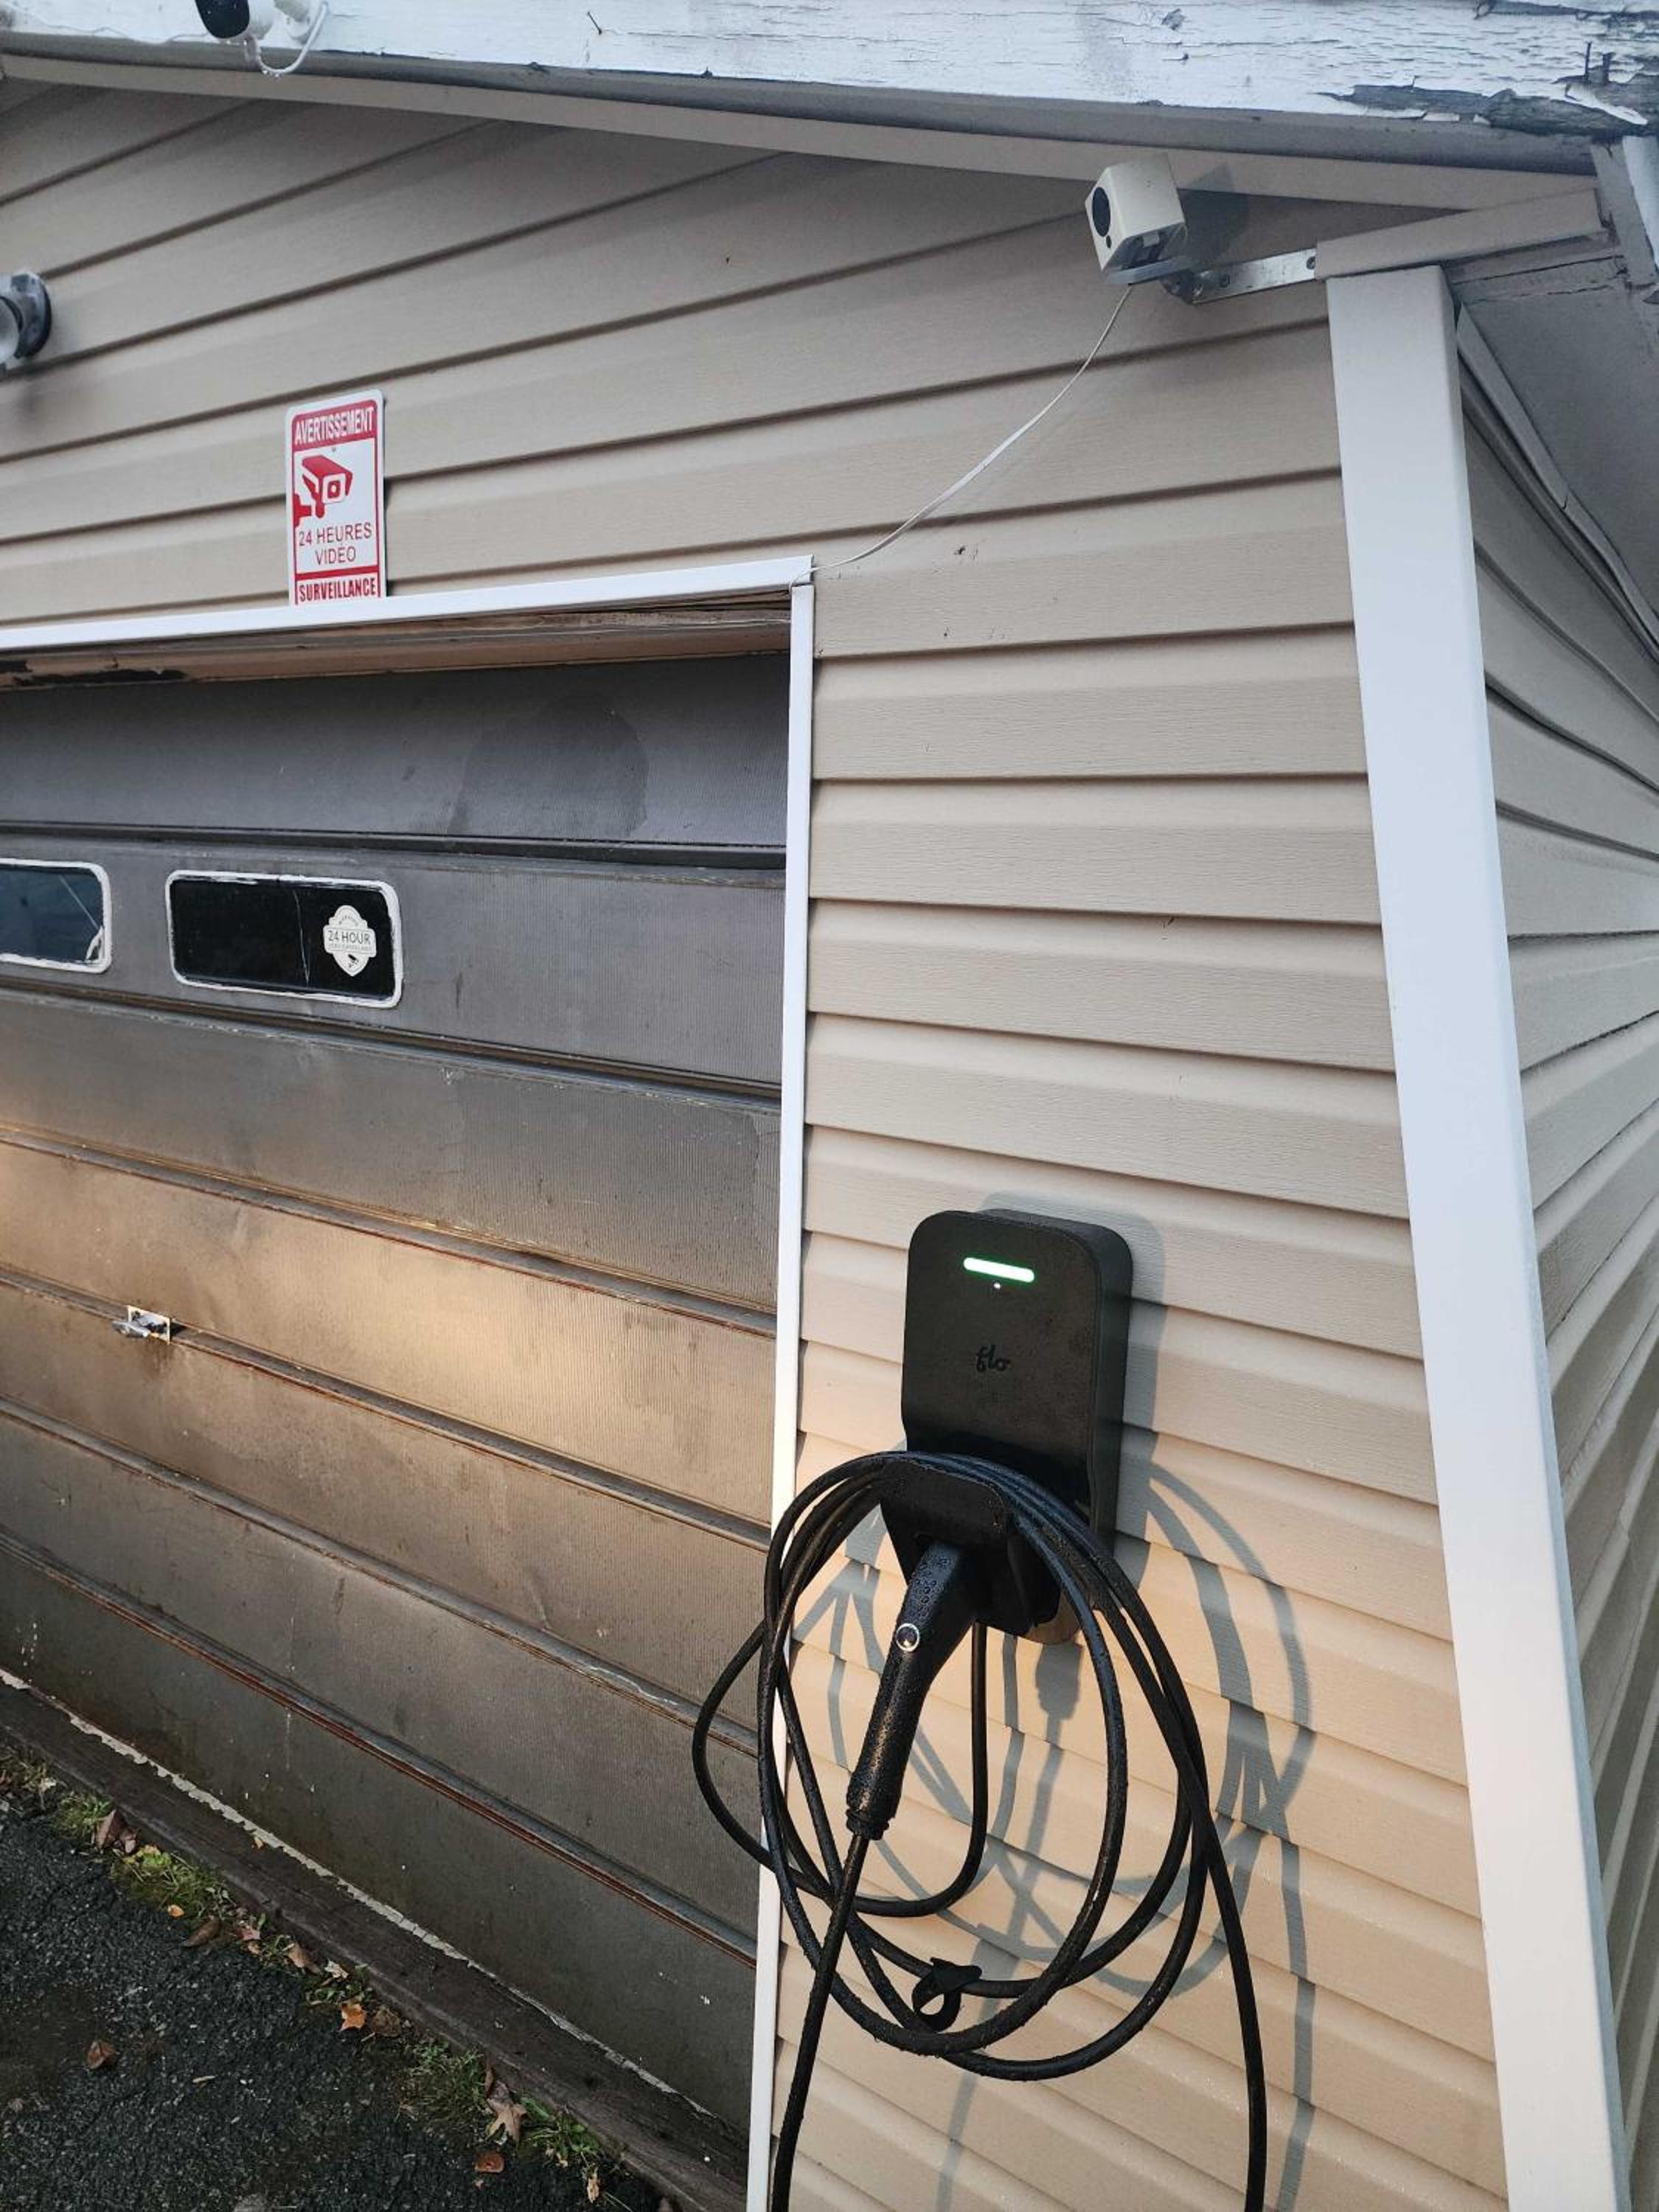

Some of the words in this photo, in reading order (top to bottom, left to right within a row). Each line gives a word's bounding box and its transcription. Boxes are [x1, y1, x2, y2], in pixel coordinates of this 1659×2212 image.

[295, 407, 374, 444] AVERTISSEMENT
[299, 530, 312, 546] 24
[316, 522, 372, 544] HEURES
[299, 578, 377, 602] SURVEILLANCE
[328, 930, 339, 942] 24
[341, 931, 371, 945] HOUR
[976, 1345, 1011, 1372] flo
